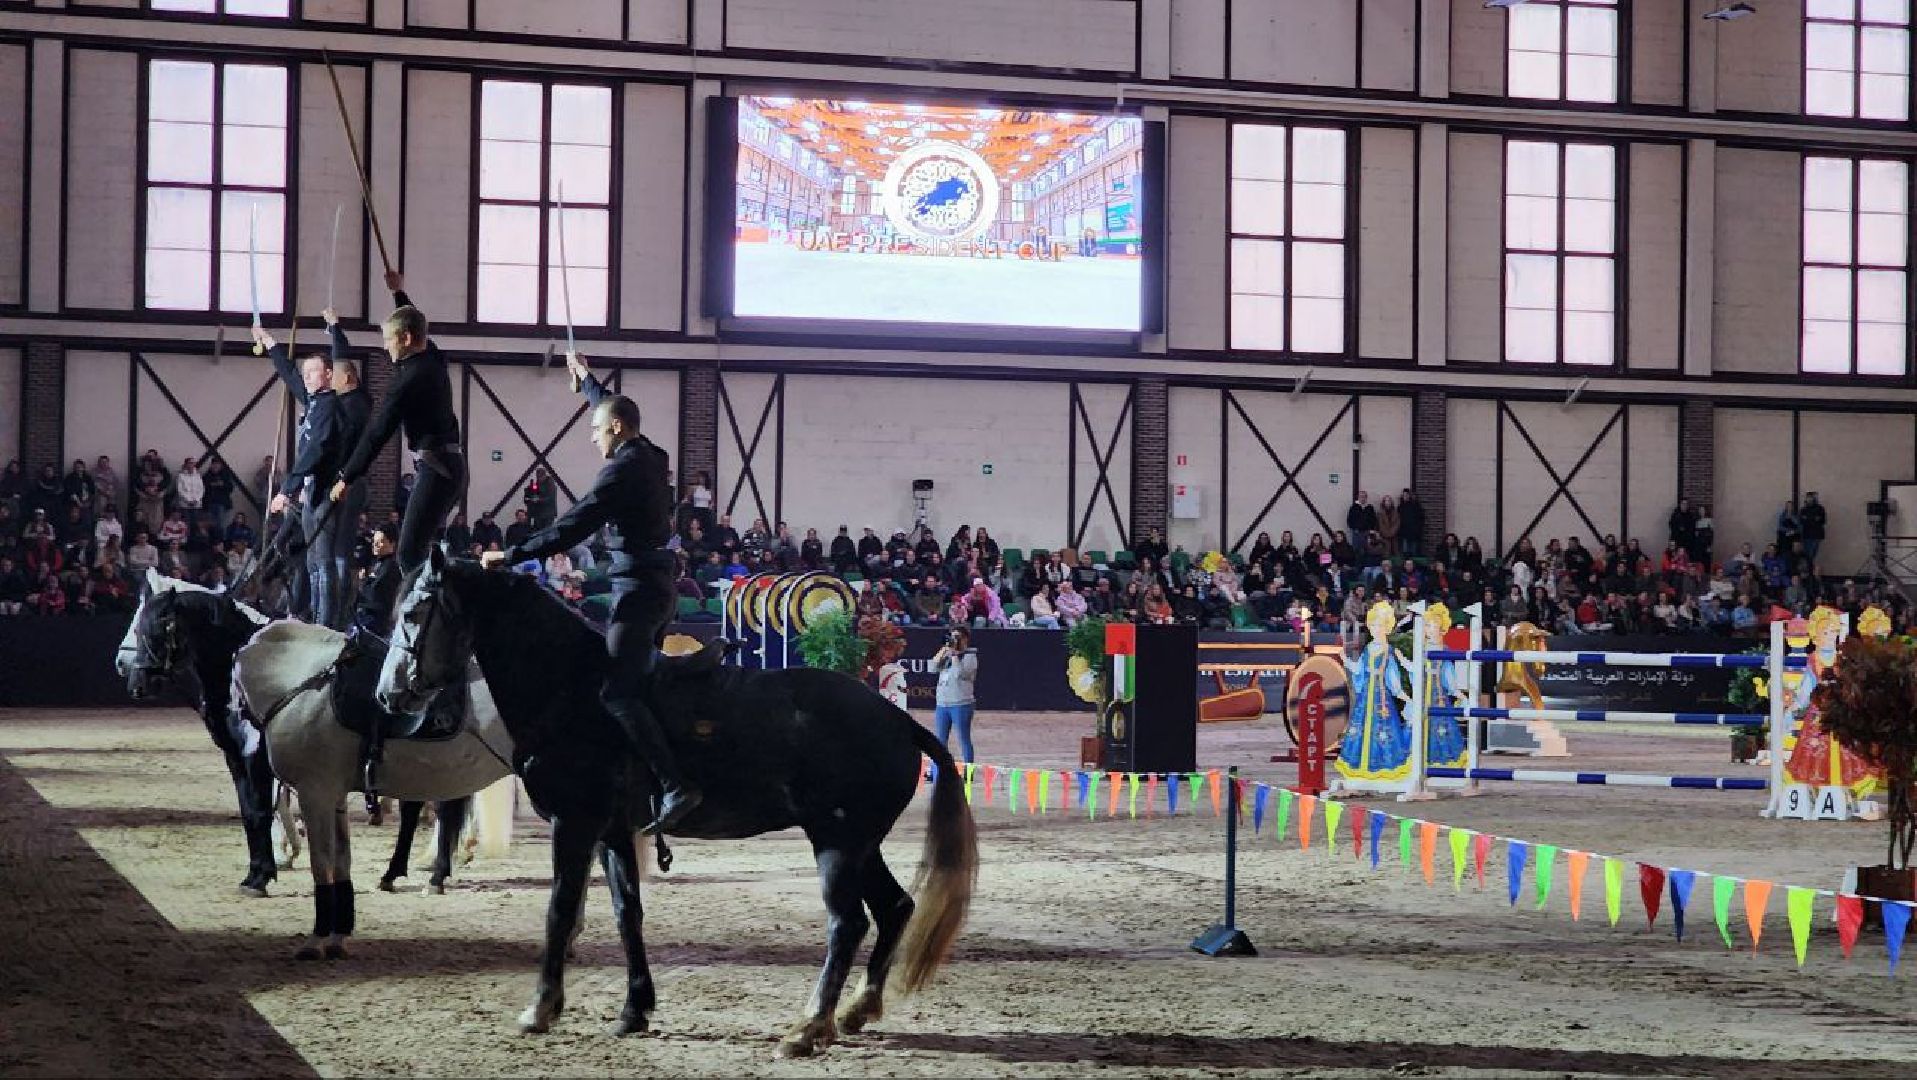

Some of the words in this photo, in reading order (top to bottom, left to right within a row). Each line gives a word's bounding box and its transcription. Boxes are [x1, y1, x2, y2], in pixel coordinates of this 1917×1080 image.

[797, 230, 850, 252] UAE
[856, 233, 1003, 259] PRESIDENT
[1307, 703, 1317, 773] СТАРТ
[1789, 789, 1799, 811] 9
[1821, 791, 1835, 814] A
